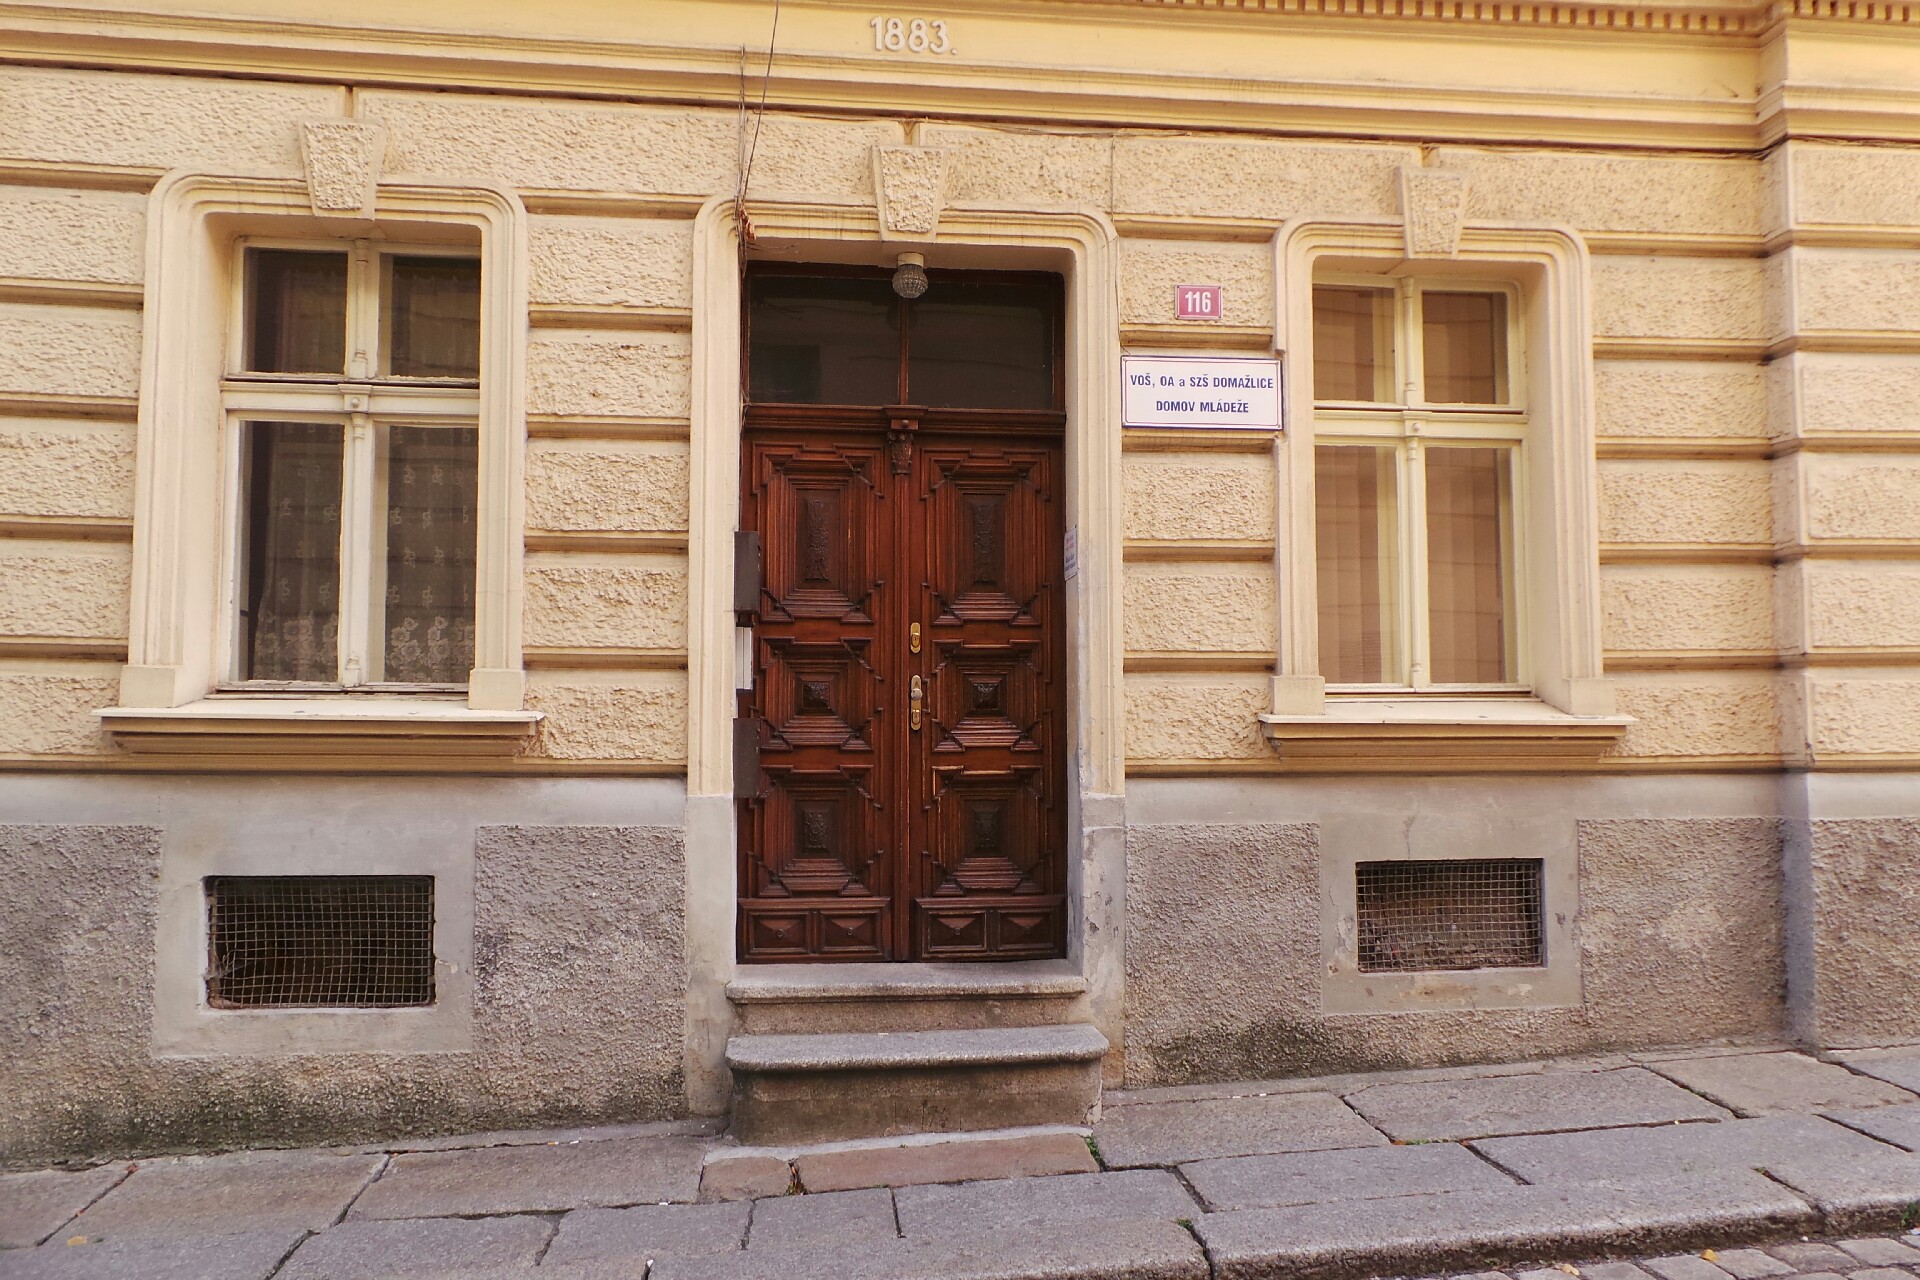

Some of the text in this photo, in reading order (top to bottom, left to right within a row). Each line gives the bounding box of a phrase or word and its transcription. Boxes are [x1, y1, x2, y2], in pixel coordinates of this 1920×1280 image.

[1185, 291, 1211, 313] 116
[1130, 372, 1274, 389] VOŠ, OA a SZŠ DOMAŽLICE
[1156, 398, 1249, 413] DOMOV MLÁDEŽE
